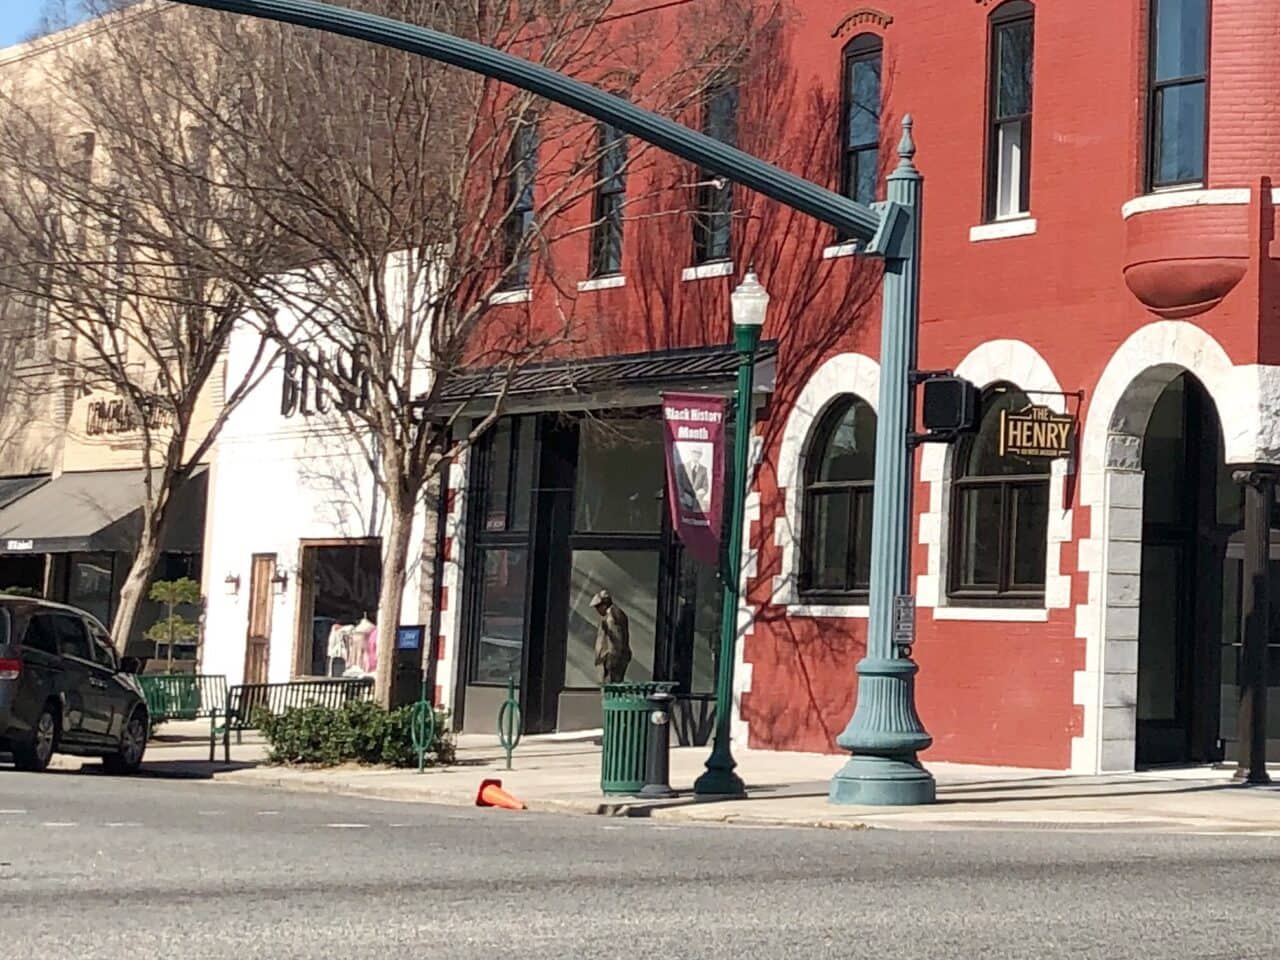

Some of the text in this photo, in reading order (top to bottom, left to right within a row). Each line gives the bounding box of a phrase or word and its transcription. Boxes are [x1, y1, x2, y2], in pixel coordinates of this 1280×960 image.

[664, 407, 722, 423] Black History
[1032, 407, 1049, 420] THE
[678, 426, 709, 440] Month
[1008, 421, 1070, 449] HENRY
